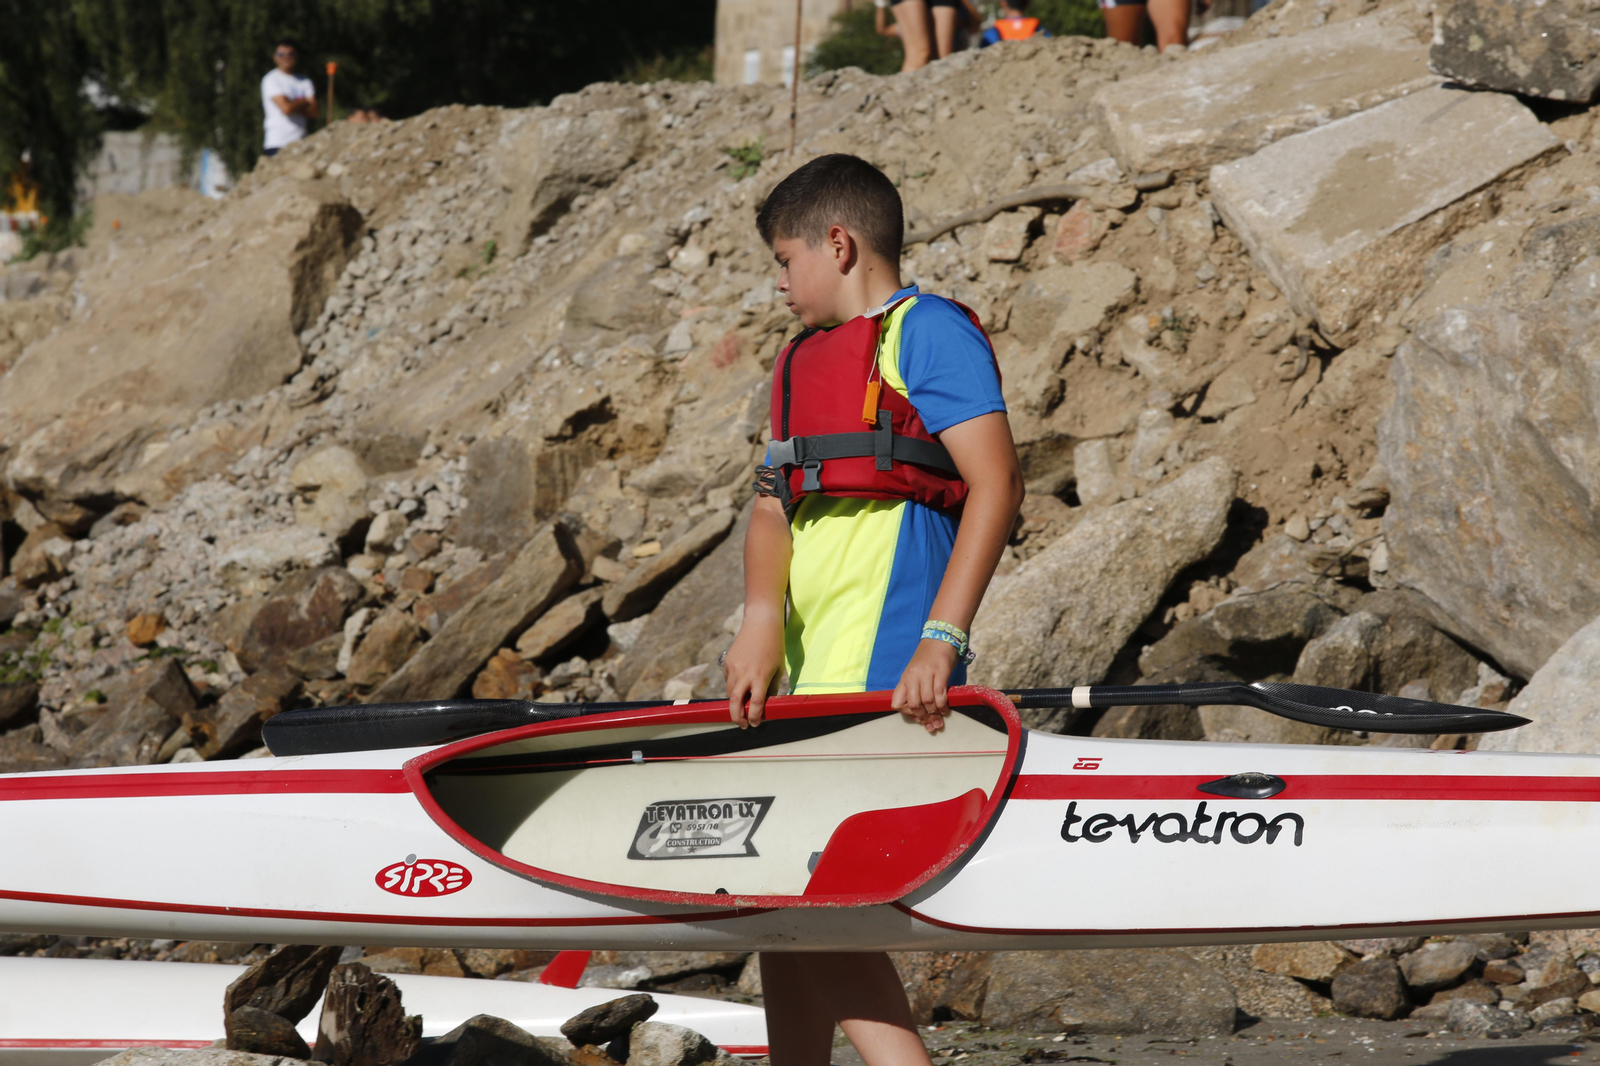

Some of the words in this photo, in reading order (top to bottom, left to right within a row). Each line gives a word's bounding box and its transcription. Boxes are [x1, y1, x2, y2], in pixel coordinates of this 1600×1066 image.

[646, 803, 733, 823] TEVATRON
[738, 802, 755, 818] LX
[686, 823, 719, 831] 5951/18
[1060, 801, 1305, 847] tevatron
[666, 837, 722, 847] CONSTRUCTION
